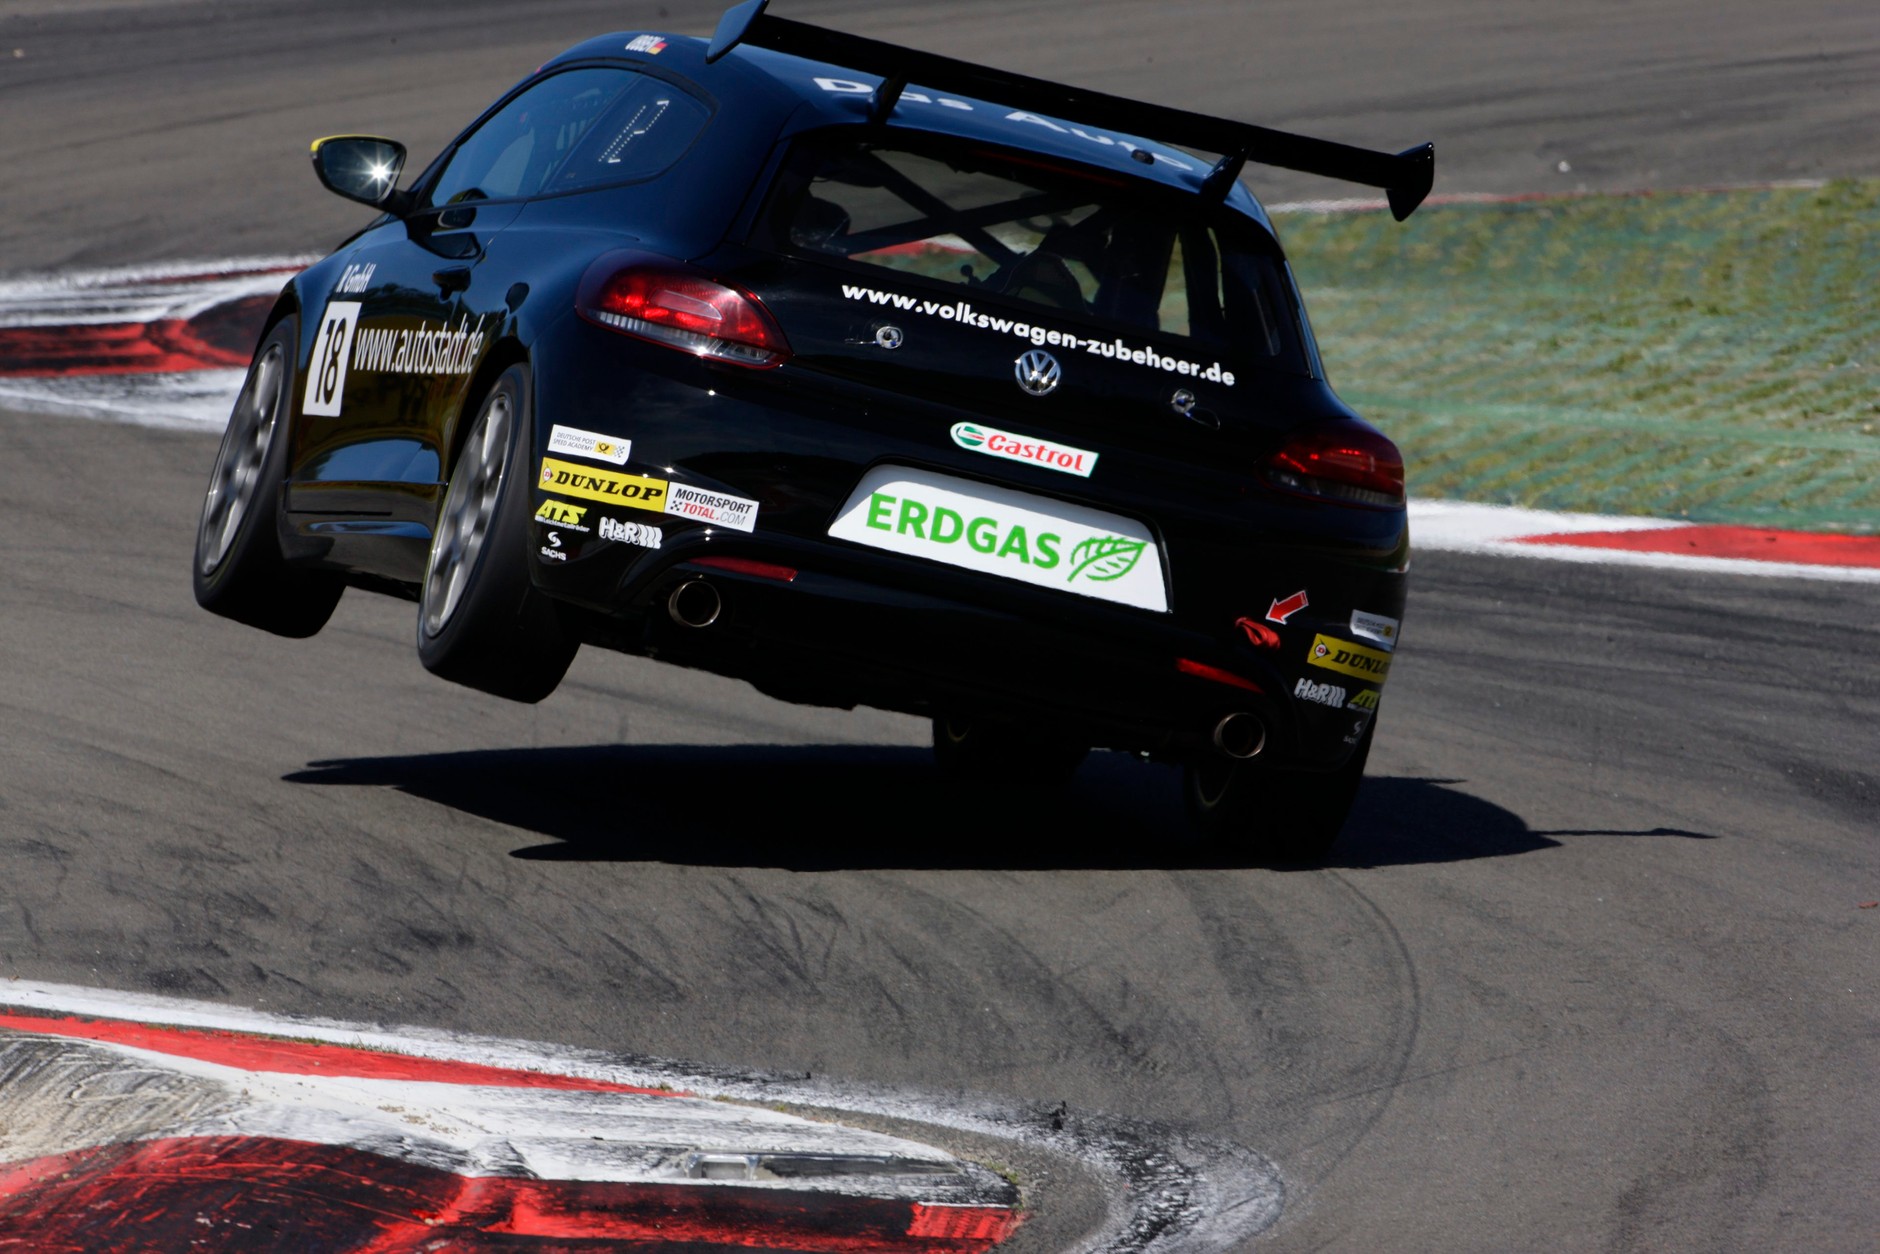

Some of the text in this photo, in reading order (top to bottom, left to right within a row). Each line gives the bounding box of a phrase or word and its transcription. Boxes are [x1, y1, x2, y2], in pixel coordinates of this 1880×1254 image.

[343, 261, 377, 294] GmbH
[353, 312, 486, 375] www.autostadt.de
[841, 283, 1236, 387] www.volkswagen-zubehoer.de
[314, 316, 348, 406] 18
[553, 438, 593, 452] SPEED ACADEMY
[556, 431, 597, 445] DEUTSCHE POST
[986, 433, 1085, 472] Castrol
[554, 470, 664, 501] DUNLOP
[675, 487, 754, 515] MOTORSPORT
[535, 498, 588, 525] ATS
[683, 502, 747, 526] TOTAL.COM
[865, 490, 1062, 570] ERDGAS
[541, 546, 567, 561] SACHS
